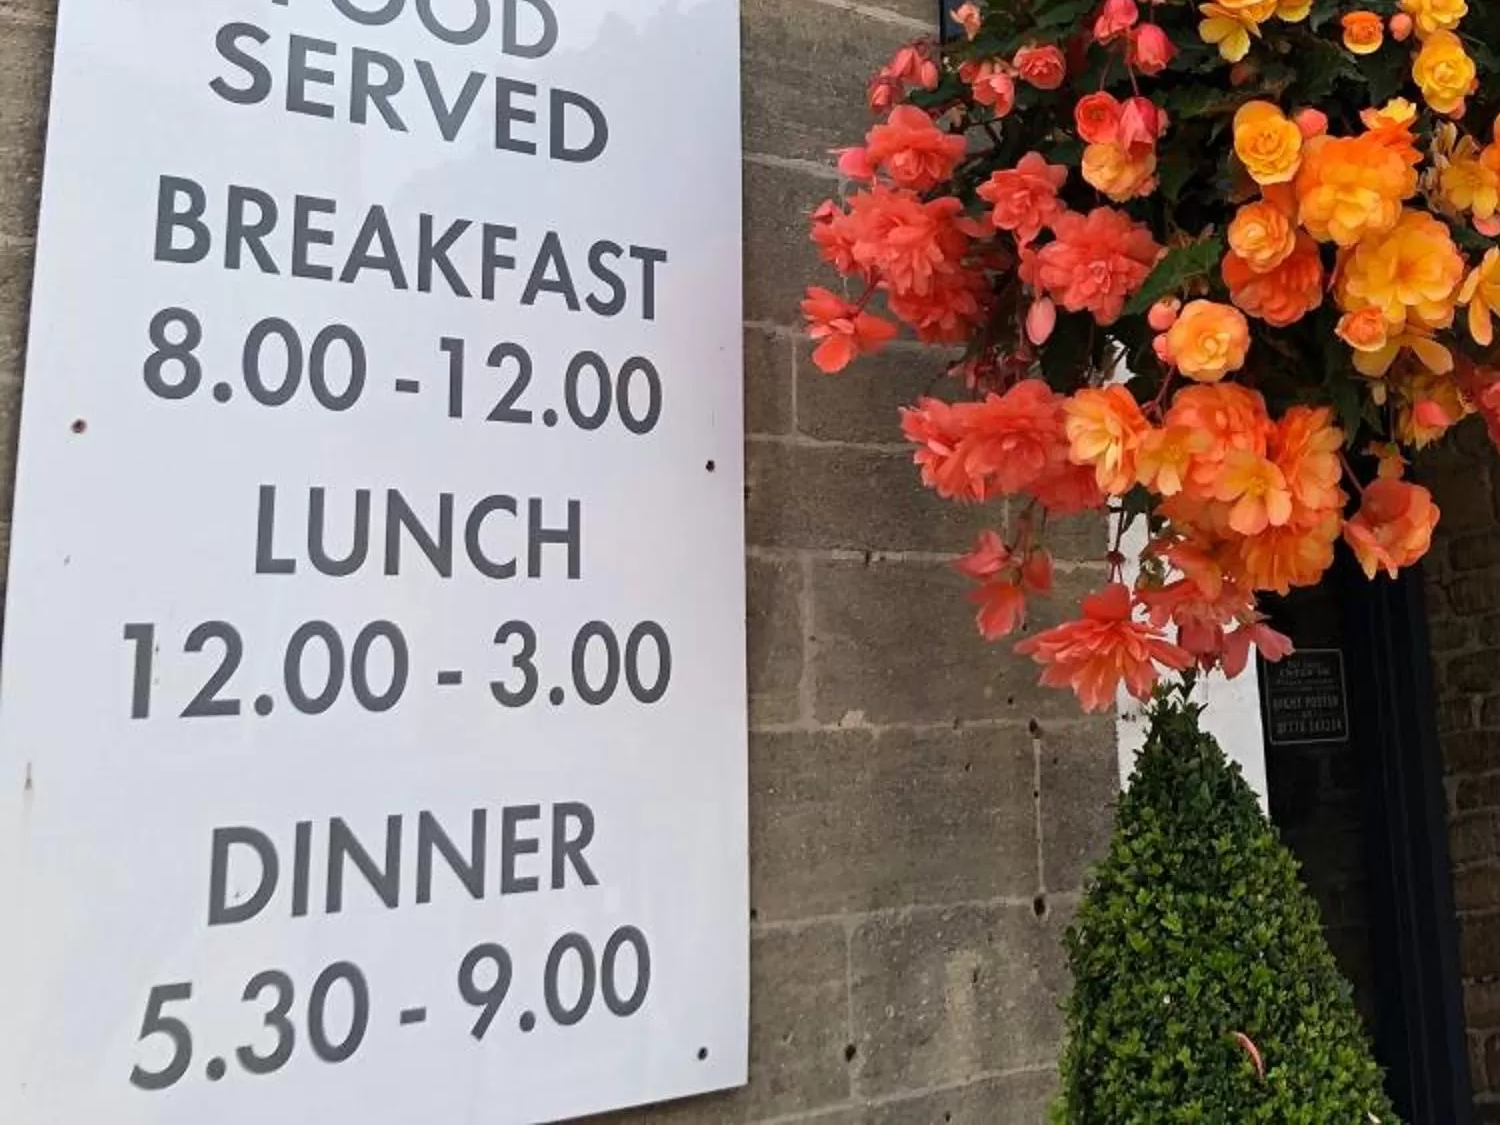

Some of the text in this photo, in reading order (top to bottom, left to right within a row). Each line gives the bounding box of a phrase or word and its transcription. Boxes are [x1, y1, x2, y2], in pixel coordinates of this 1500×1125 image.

[208, 21, 609, 164] SERVED
[153, 174, 668, 322] BREAKFAST
[143, 306, 367, 412] 8.00
[439, 336, 663, 436] 12.00
[255, 484, 581, 580] LUNCH
[123, 619, 409, 720] 12.00
[489, 619, 673, 708] 3.00
[207, 801, 600, 927] DINNER
[129, 960, 370, 1091] 5.30
[457, 924, 651, 1042] 9.00
